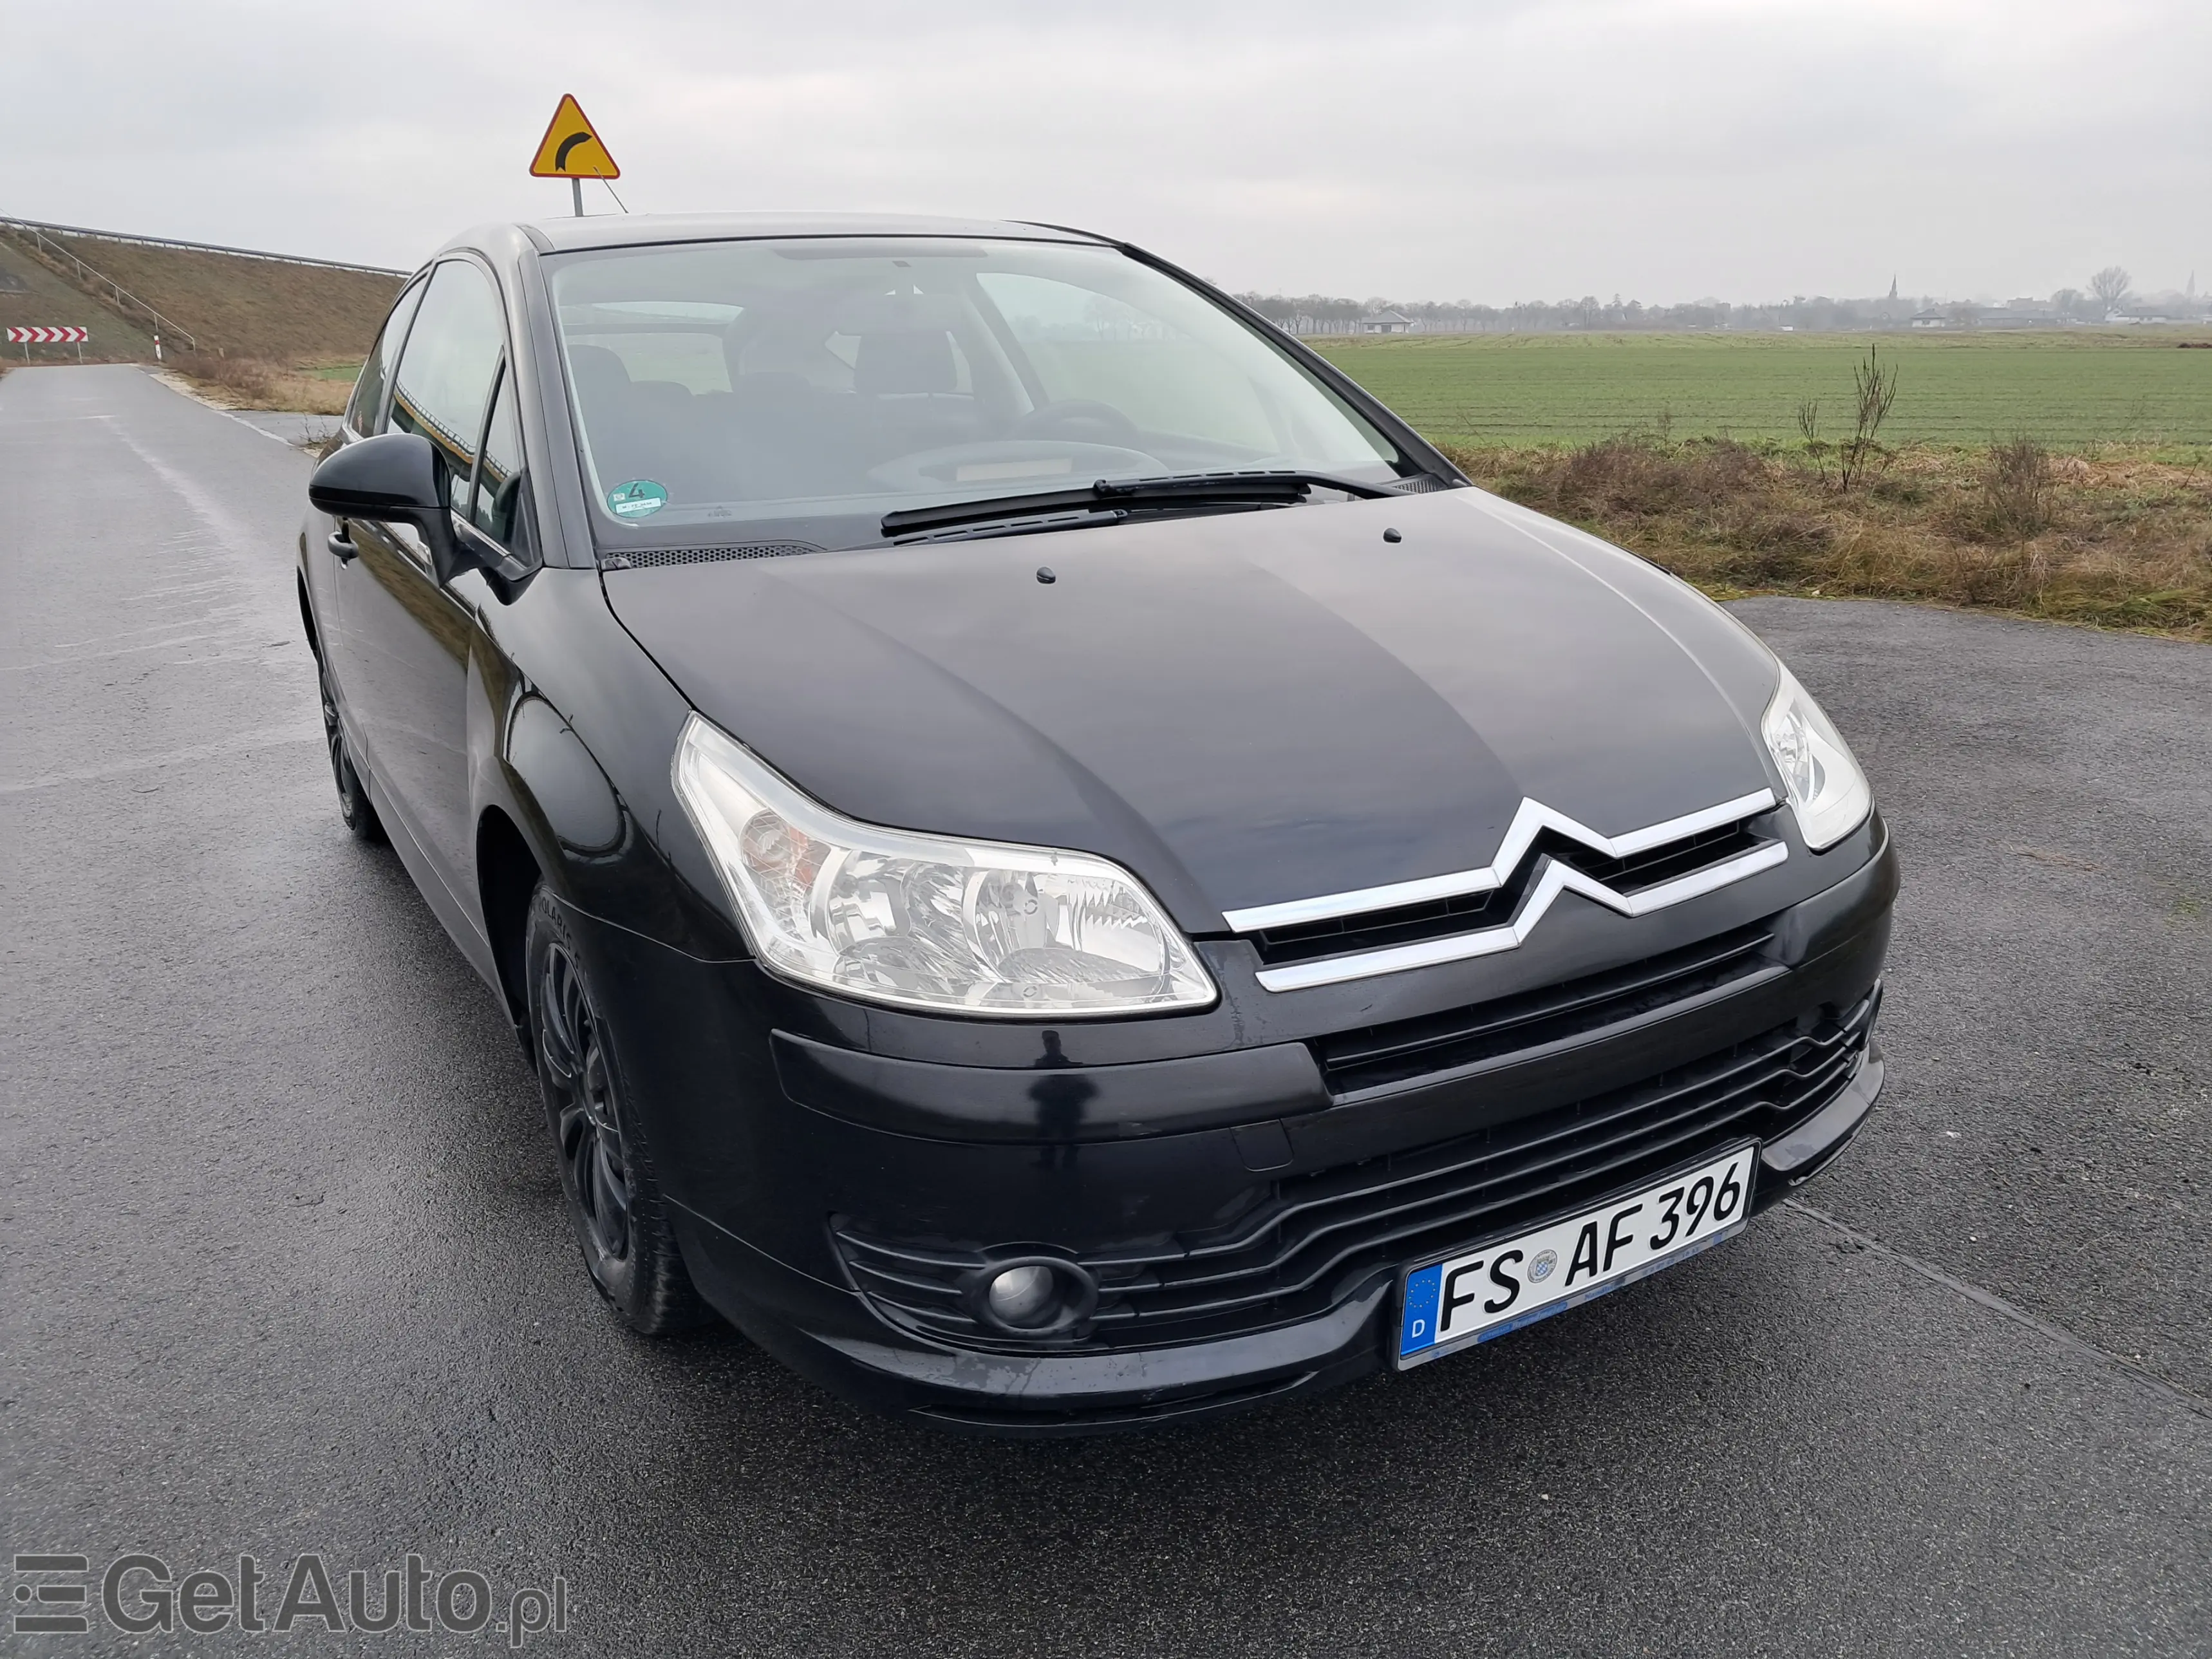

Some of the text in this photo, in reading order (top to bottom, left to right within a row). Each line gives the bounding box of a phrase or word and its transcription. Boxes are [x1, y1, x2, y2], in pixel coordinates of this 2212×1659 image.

[628, 483, 645, 498] 4
[1440, 1250, 1523, 1331] FS
[1564, 1203, 1643, 1286] AF
[1650, 1161, 1740, 1250] 396
[1412, 1320, 1425, 1338] D
